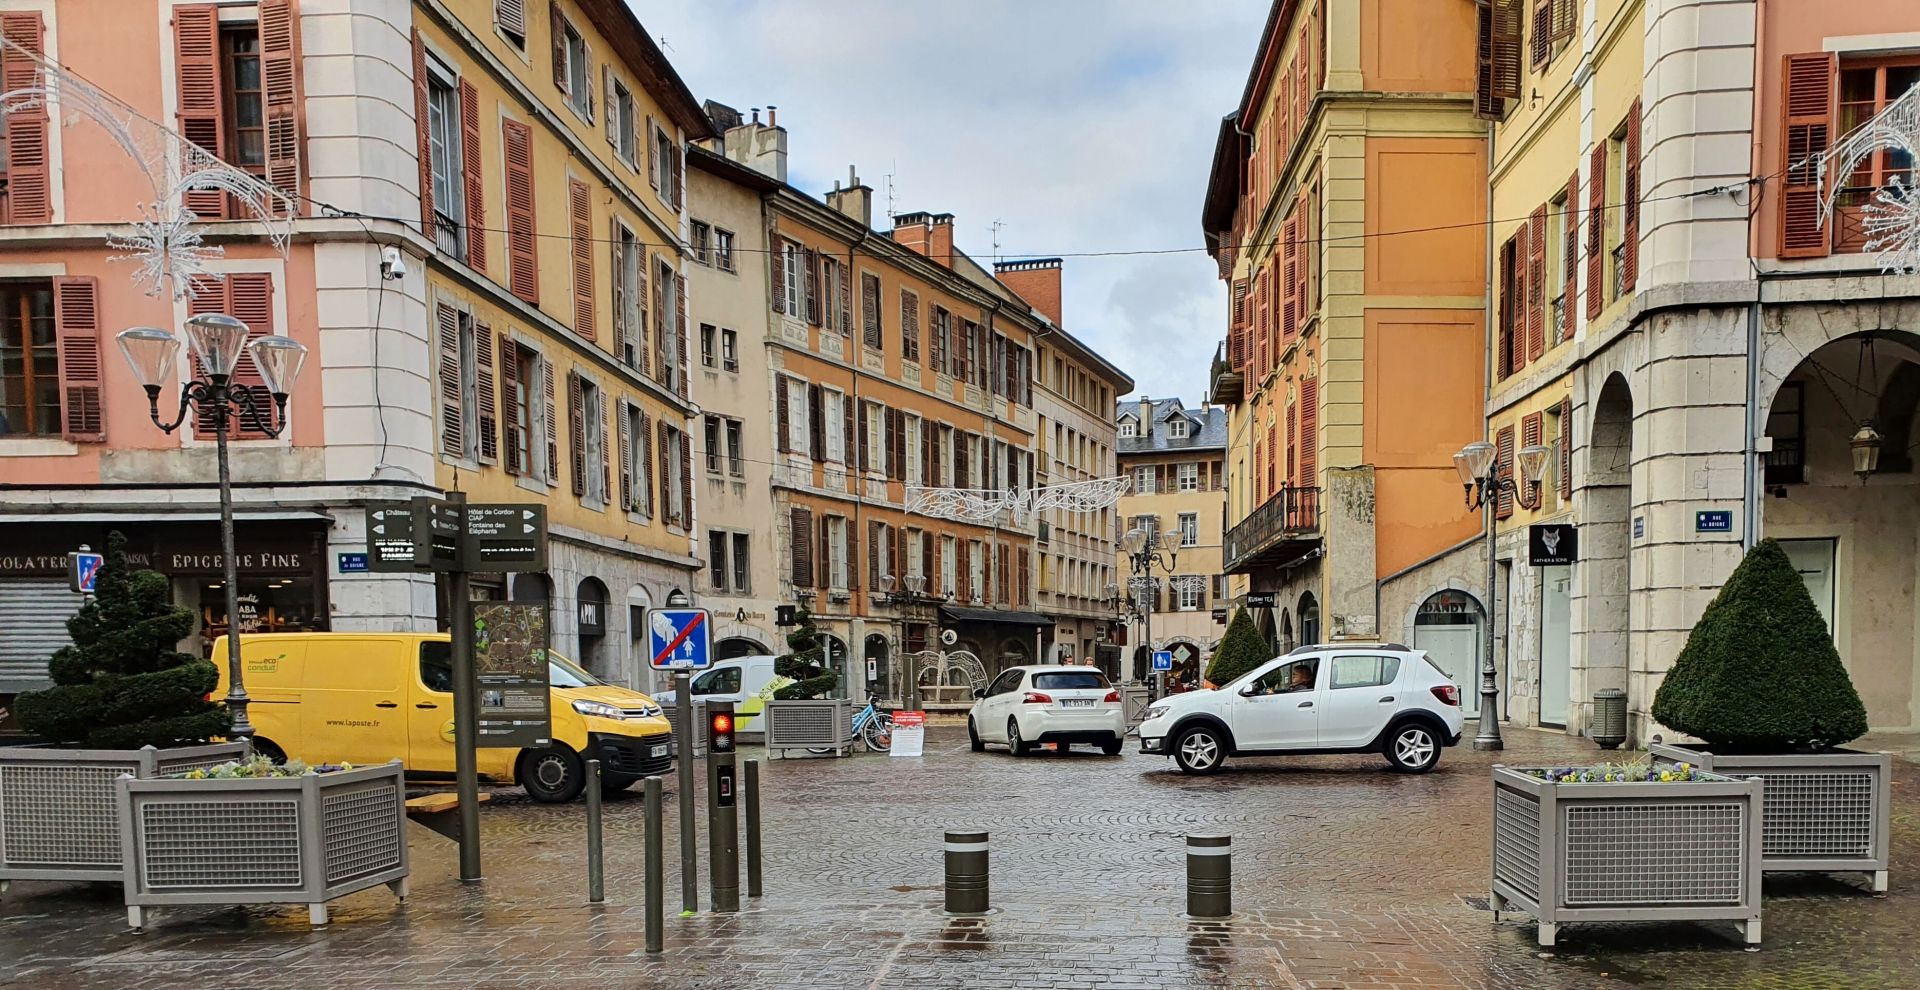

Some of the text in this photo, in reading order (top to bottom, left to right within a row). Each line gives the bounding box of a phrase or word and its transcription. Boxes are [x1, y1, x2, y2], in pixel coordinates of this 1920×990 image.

[172, 554, 253, 568] EPICEIE
[261, 553, 300, 568] FINE
[238, 605, 257, 614] ABA
[1425, 603, 1467, 613] DANDY
[580, 604, 597, 625] APRIL
[326, 719, 380, 727] www.laposte.fr
